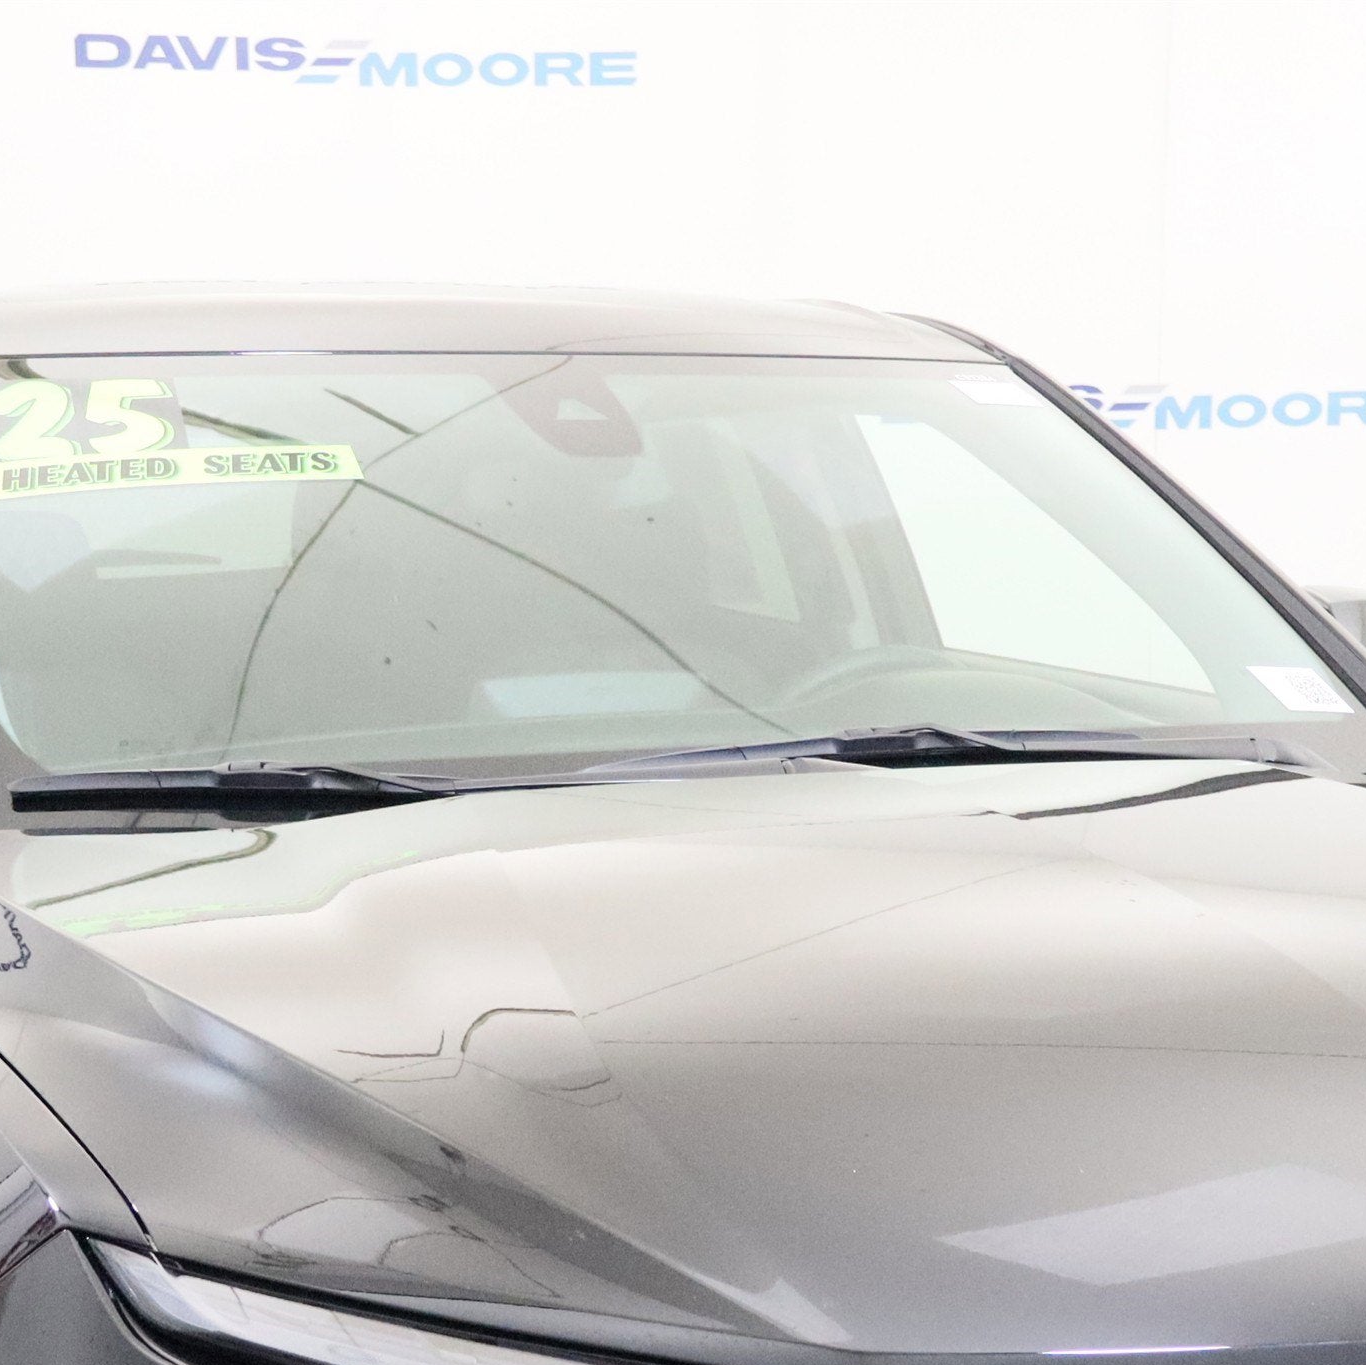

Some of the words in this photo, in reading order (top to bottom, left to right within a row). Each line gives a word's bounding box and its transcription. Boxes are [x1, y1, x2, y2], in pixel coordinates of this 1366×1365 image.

[74, 33, 306, 71] DAVIS
[358, 51, 638, 87] MOORE
[1, 455, 178, 492] HEATED
[202, 450, 338, 475] SEATS
